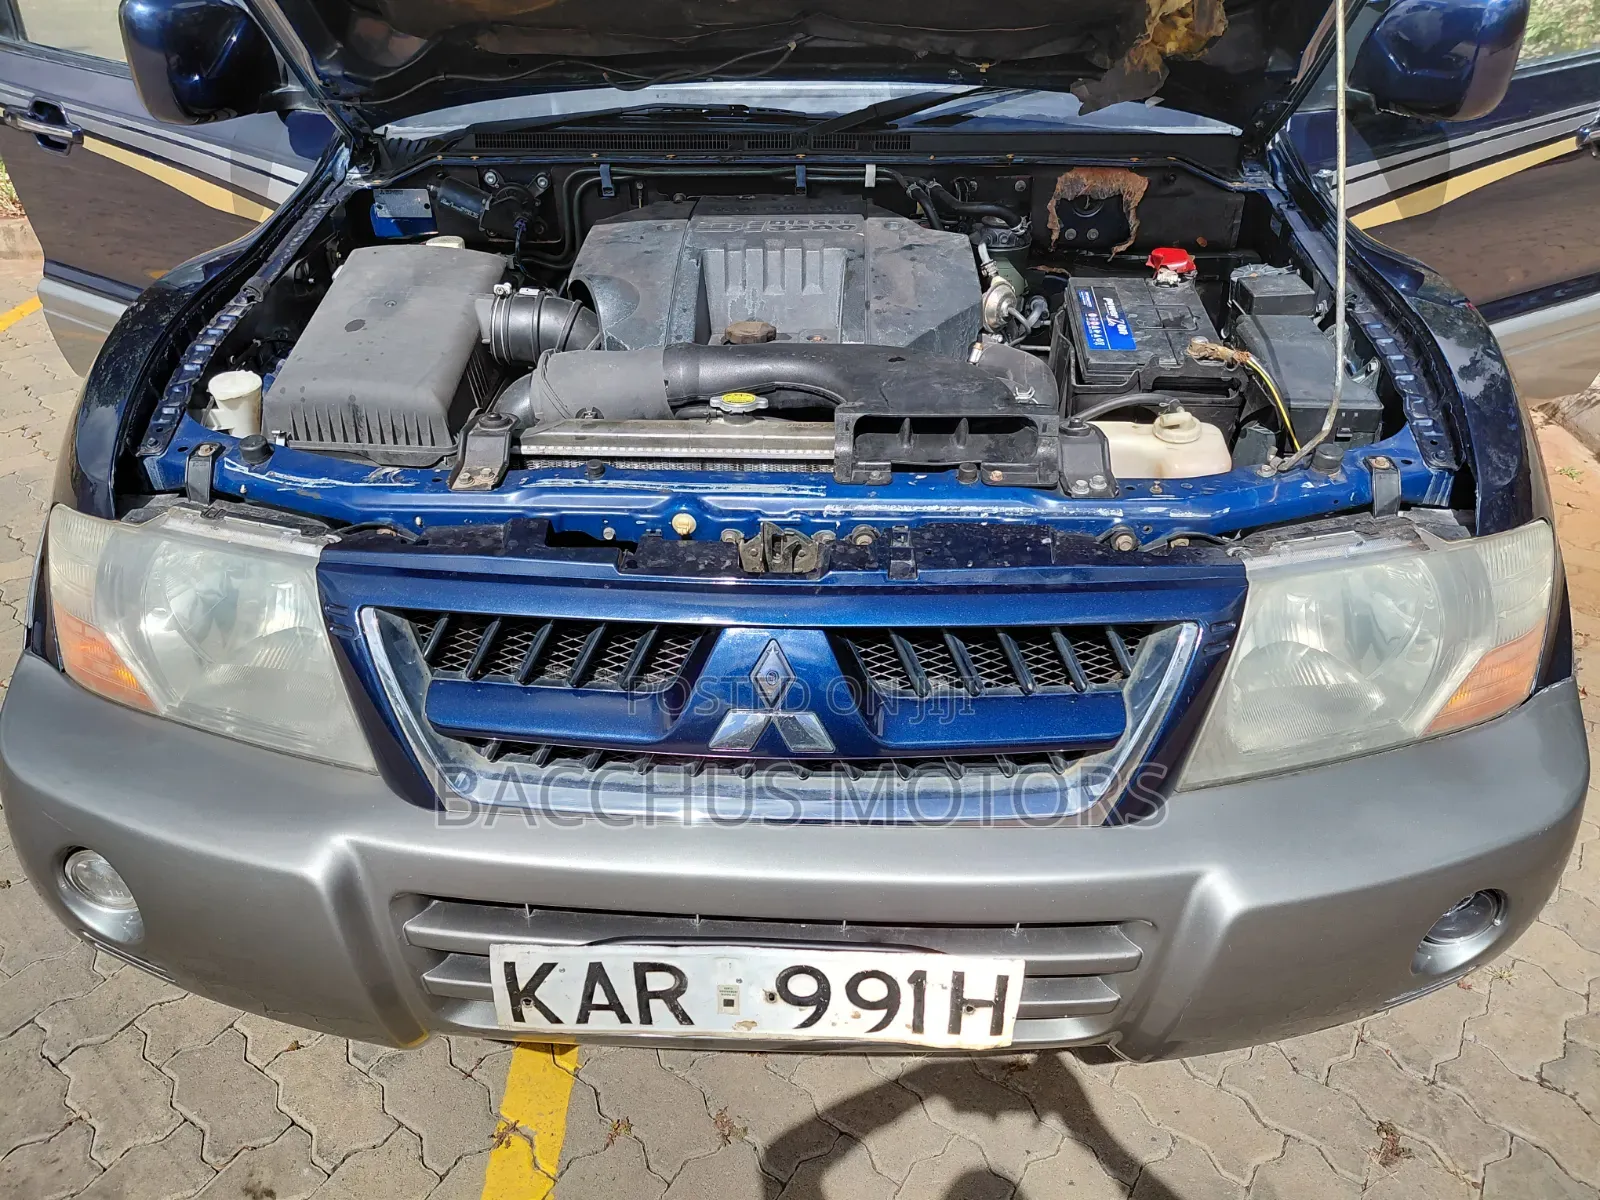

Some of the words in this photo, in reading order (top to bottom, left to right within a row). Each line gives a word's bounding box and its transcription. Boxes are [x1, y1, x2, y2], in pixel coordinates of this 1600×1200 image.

[767, 224, 858, 233] 3200
[503, 961, 695, 1026] KAR
[775, 964, 1009, 1036] 991H
